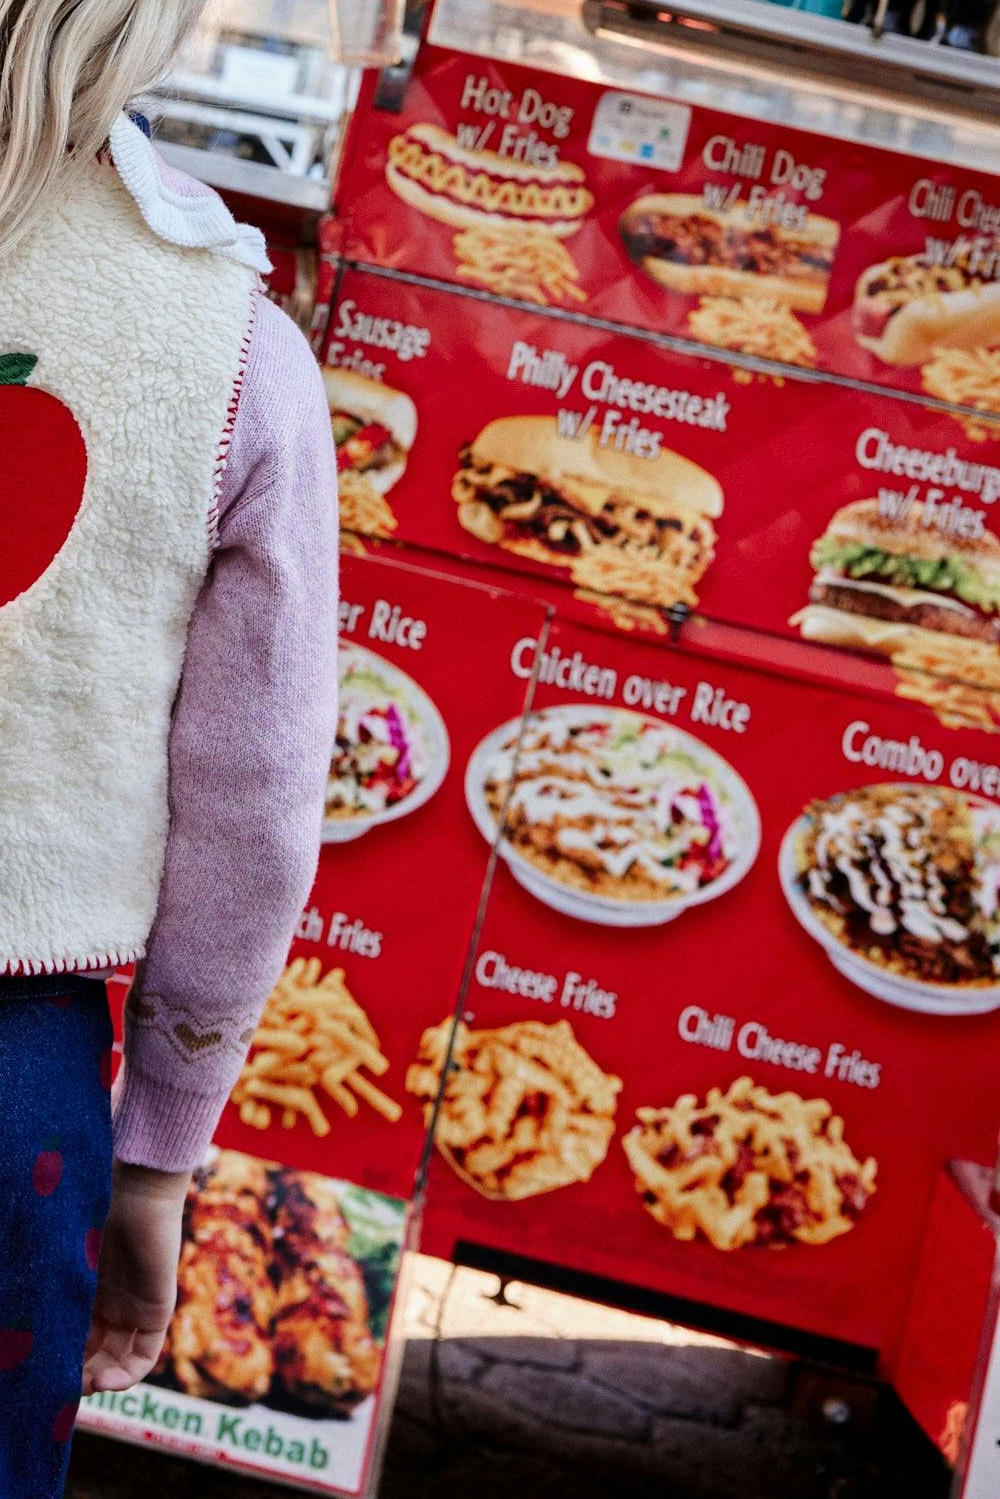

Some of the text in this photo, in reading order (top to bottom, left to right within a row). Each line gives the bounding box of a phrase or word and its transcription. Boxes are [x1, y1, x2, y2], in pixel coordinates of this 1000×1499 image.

[460, 73, 575, 139] Hot Dog
[498, 123, 560, 172] Fries
[702, 134, 828, 201] Chili Dog
[746, 185, 809, 231] Fries
[908, 178, 957, 223] Chili
[334, 299, 431, 361] Sausage
[505, 340, 731, 432] Philly Cheesesteak
[599, 409, 664, 460] Fries
[855, 427, 1000, 504] Cheeseburg
[923, 487, 987, 539] Fries
[339, 598, 427, 651] er Rice
[510, 636, 751, 734] Chicken over Rice
[842, 720, 1000, 799] Combo ove
[327, 910, 384, 959] Fries
[475, 949, 618, 1020] Cheese Fries
[678, 1004, 883, 1090] Chili Cheese Fries
[86, 1391, 204, 1435] hicken
[216, 1411, 329, 1470] Kebab
